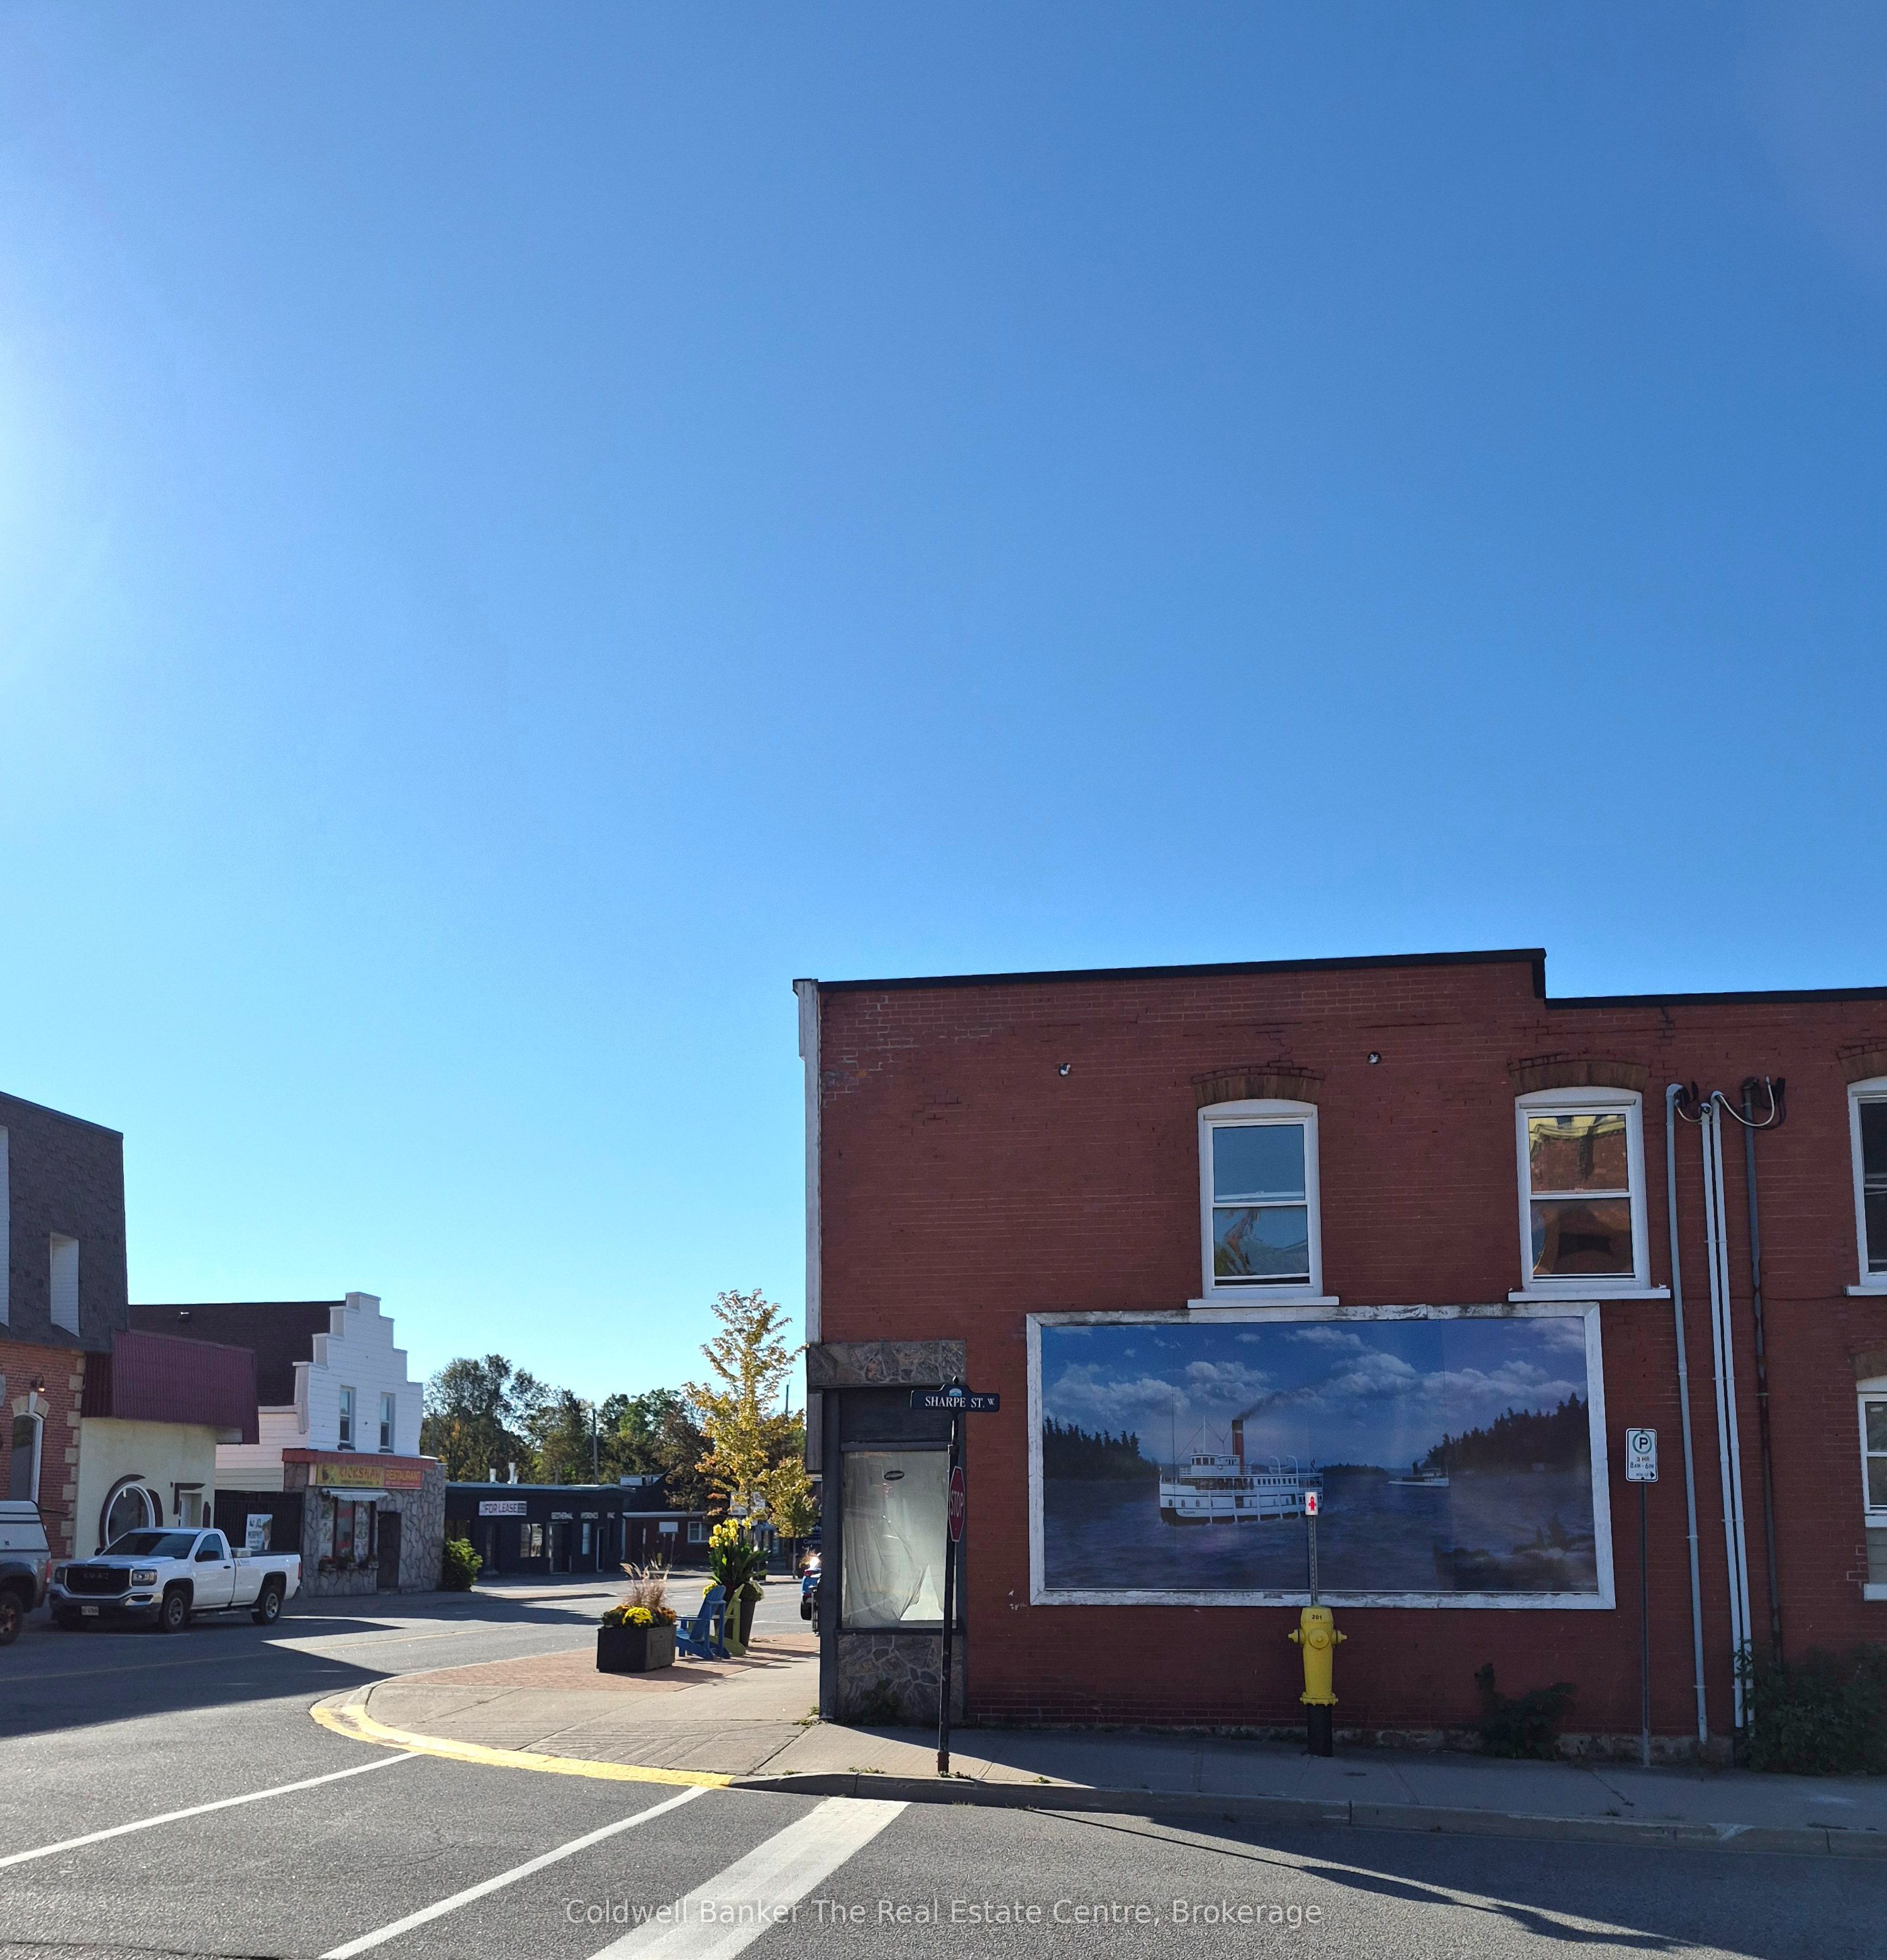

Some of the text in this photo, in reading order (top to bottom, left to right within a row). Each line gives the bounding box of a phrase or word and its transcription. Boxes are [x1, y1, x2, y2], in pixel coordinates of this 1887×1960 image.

[925, 1396, 966, 1408] SHARPE
[971, 1397, 985, 1408] ST.
[1639, 1437, 1649, 1449] P
[485, 1503, 498, 1513] FOR
[498, 1503, 518, 1513] LEASE
[950, 1489, 964, 1518] STOP
